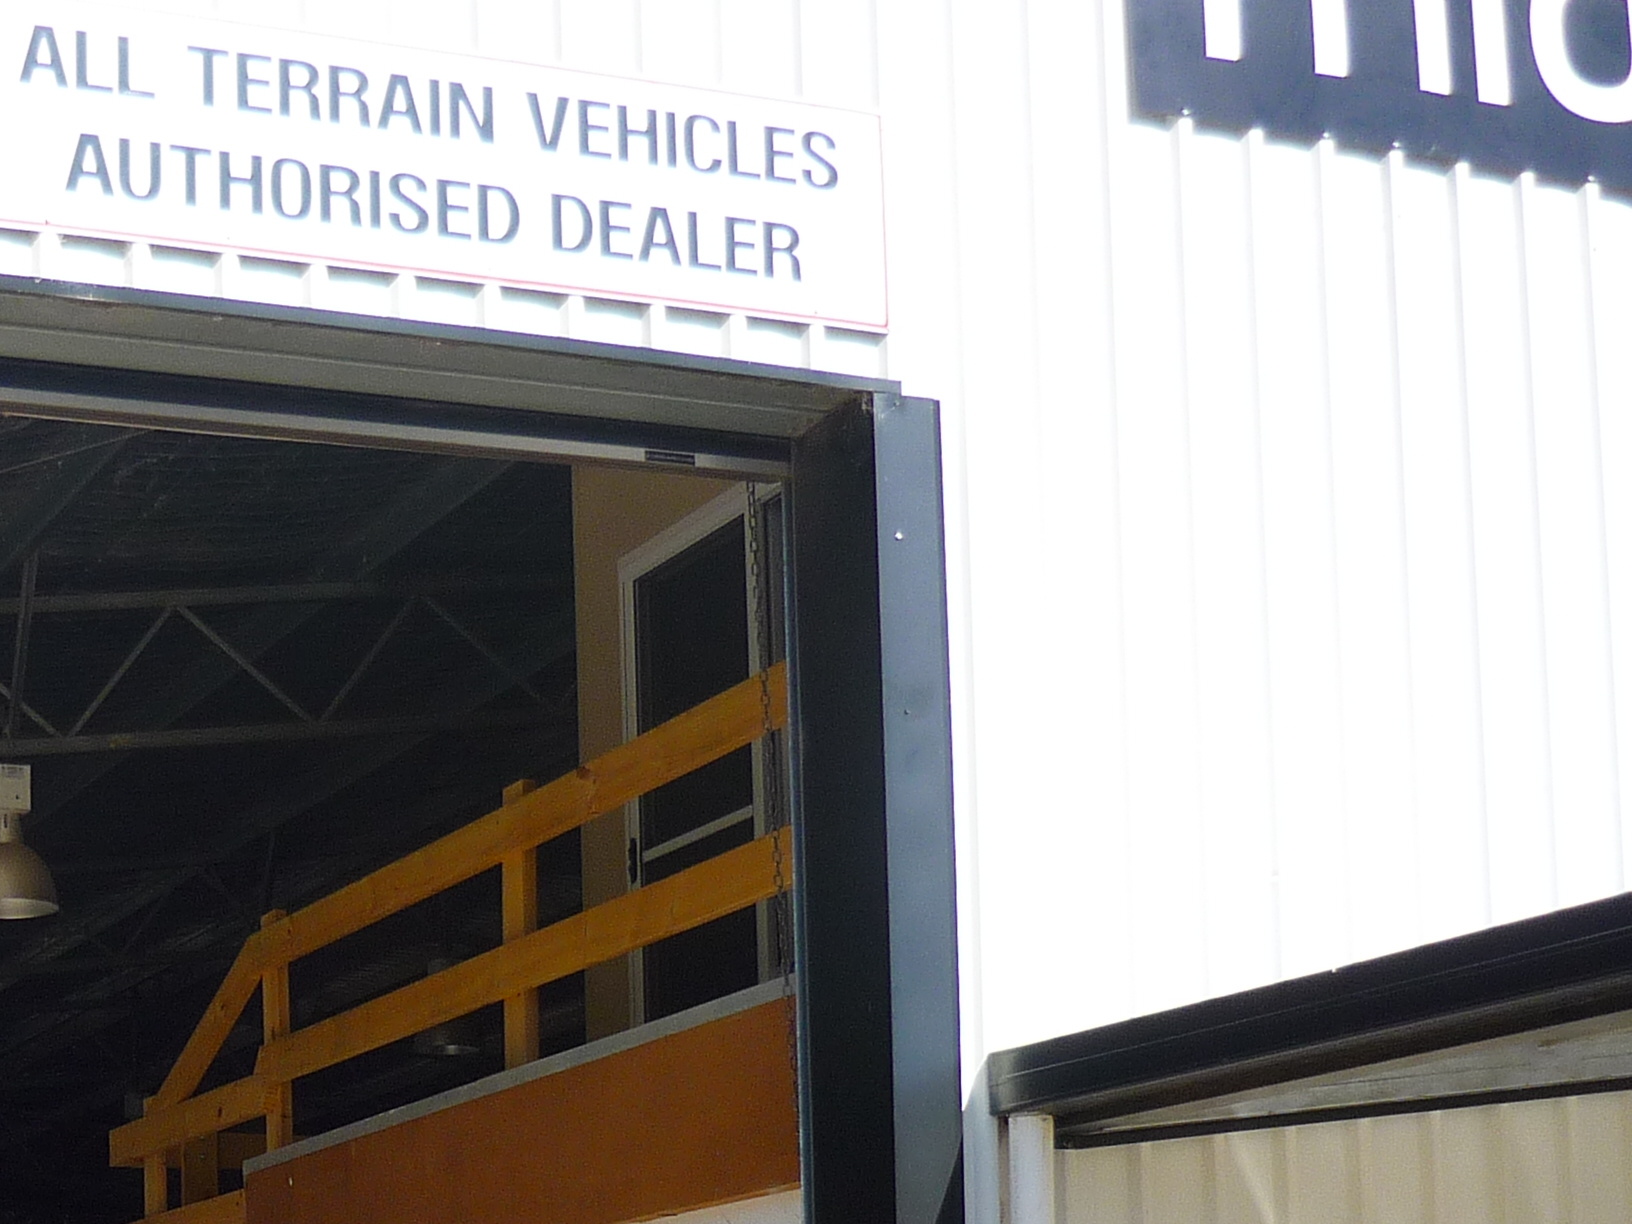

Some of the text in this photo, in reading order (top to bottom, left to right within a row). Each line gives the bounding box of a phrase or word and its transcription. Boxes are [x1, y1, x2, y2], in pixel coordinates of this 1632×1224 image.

[19, 25, 841, 191] ALL TERRAIN VEHICLES
[65, 133, 803, 282] AUTHORISED DEALER
